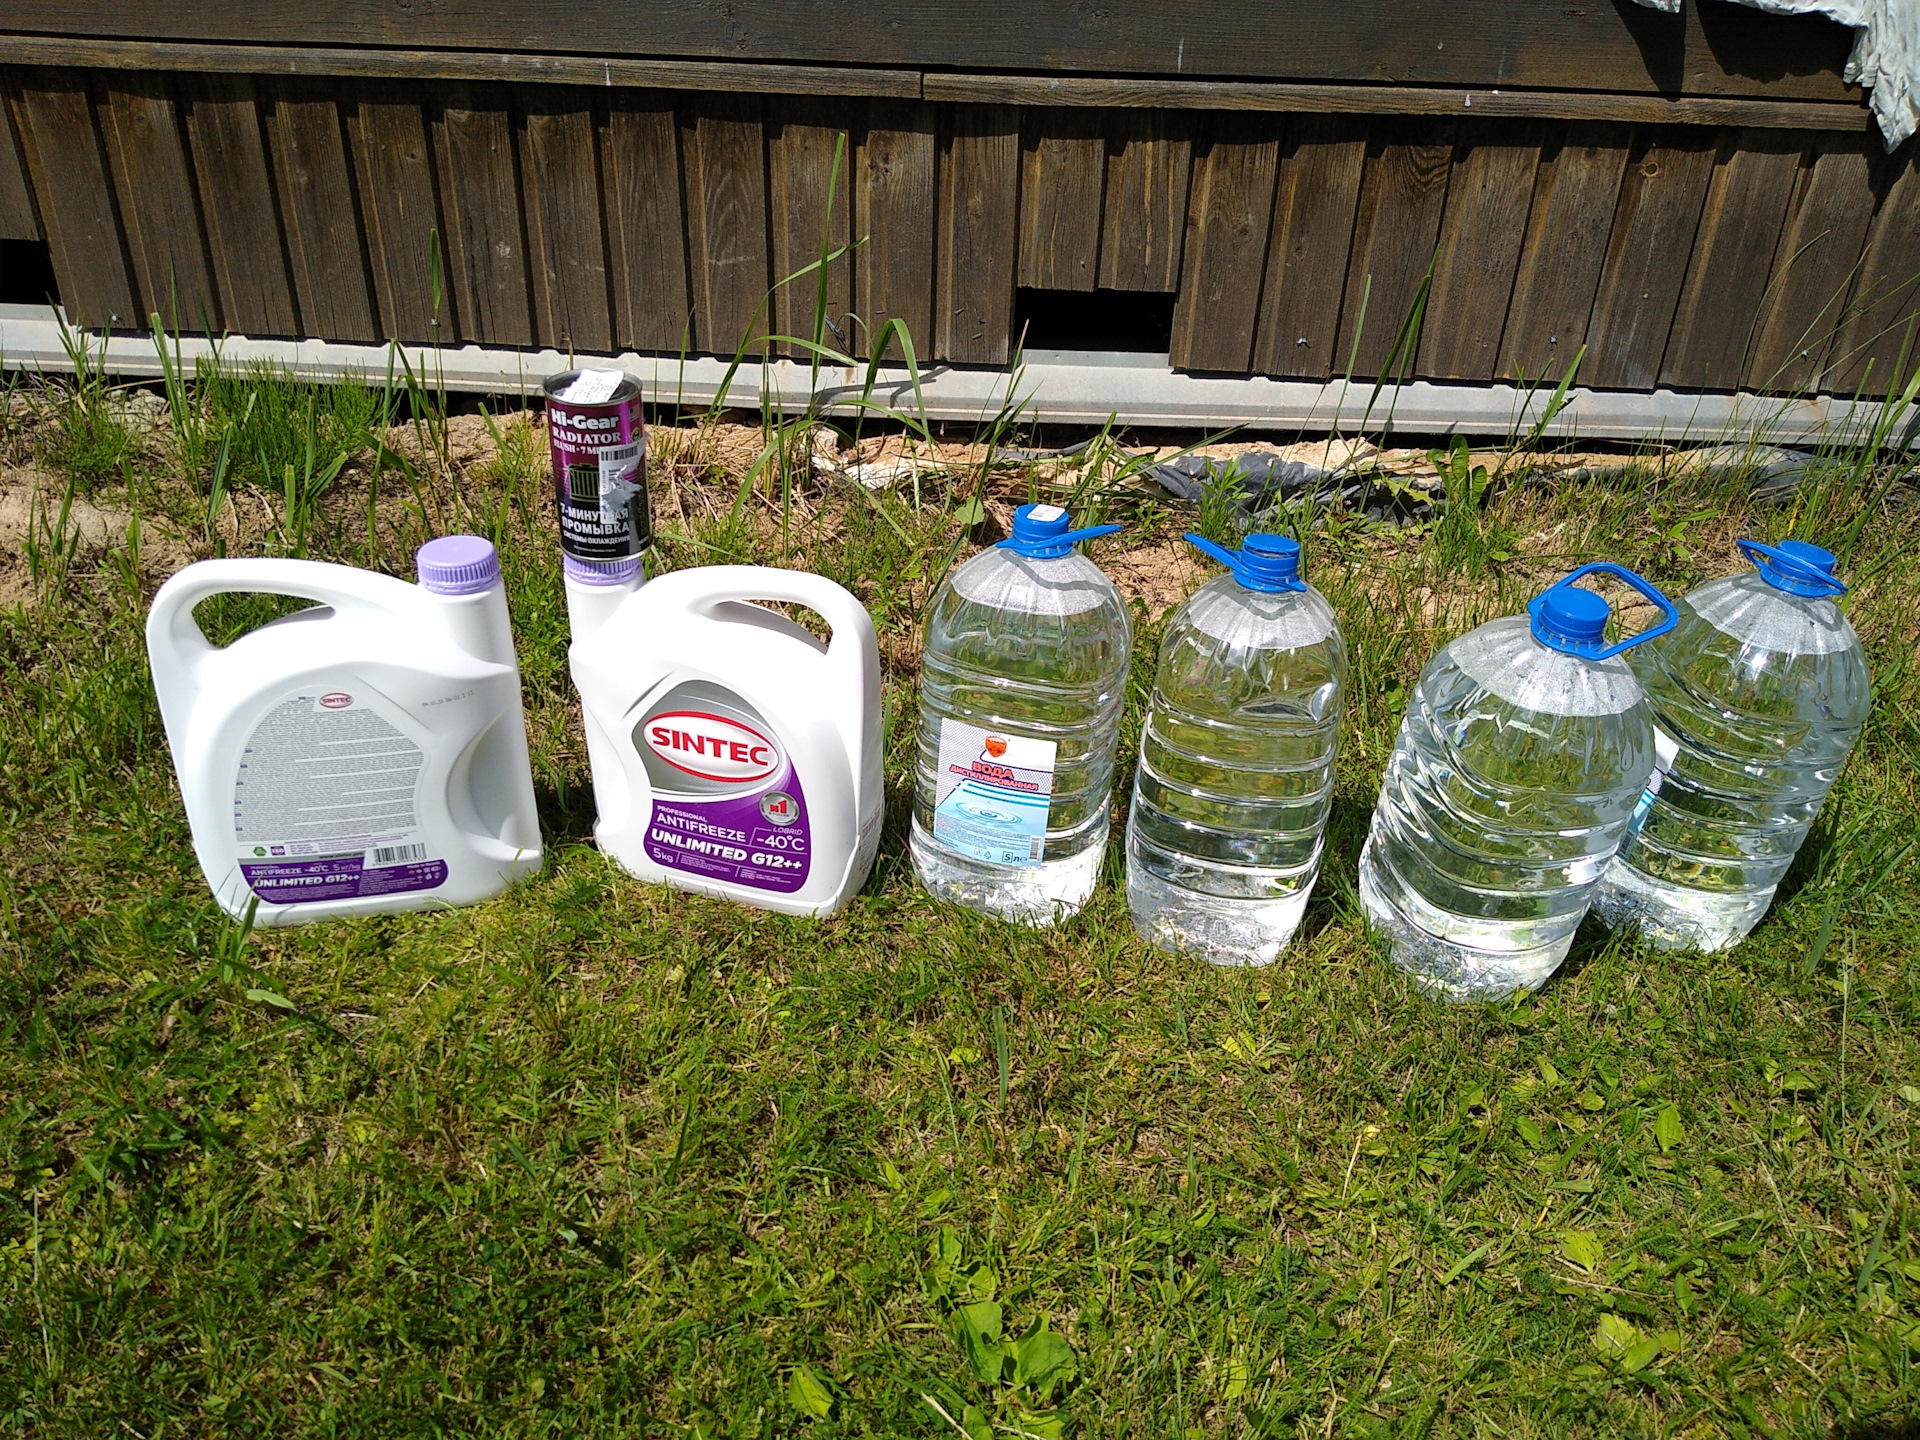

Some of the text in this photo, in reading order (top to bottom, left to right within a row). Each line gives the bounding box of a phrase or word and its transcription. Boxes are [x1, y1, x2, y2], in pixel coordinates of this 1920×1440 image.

[551, 408, 619, 430] Hi-Gear
[552, 426, 621, 444] RADIATOR
[554, 438, 576, 453] FLUSH
[561, 515, 630, 535] ПРОМЫВКА
[652, 727, 768, 766] SINTEC
[950, 765, 1038, 791] ДИСТИЛЛИРОВАННАЯ
[972, 762, 1014, 779] ВОДА
[657, 805, 707, 822] PROFESSIONAL
[656, 812, 746, 843] ANTIFREEZE
[772, 826, 803, 836] LOBRID
[652, 828, 747, 861] UNLIMITED
[751, 852, 803, 869] G12++
[251, 868, 302, 876] ANTIFREEZE
[255, 876, 322, 888] UNLIMITED
[325, 874, 360, 883] G12++
